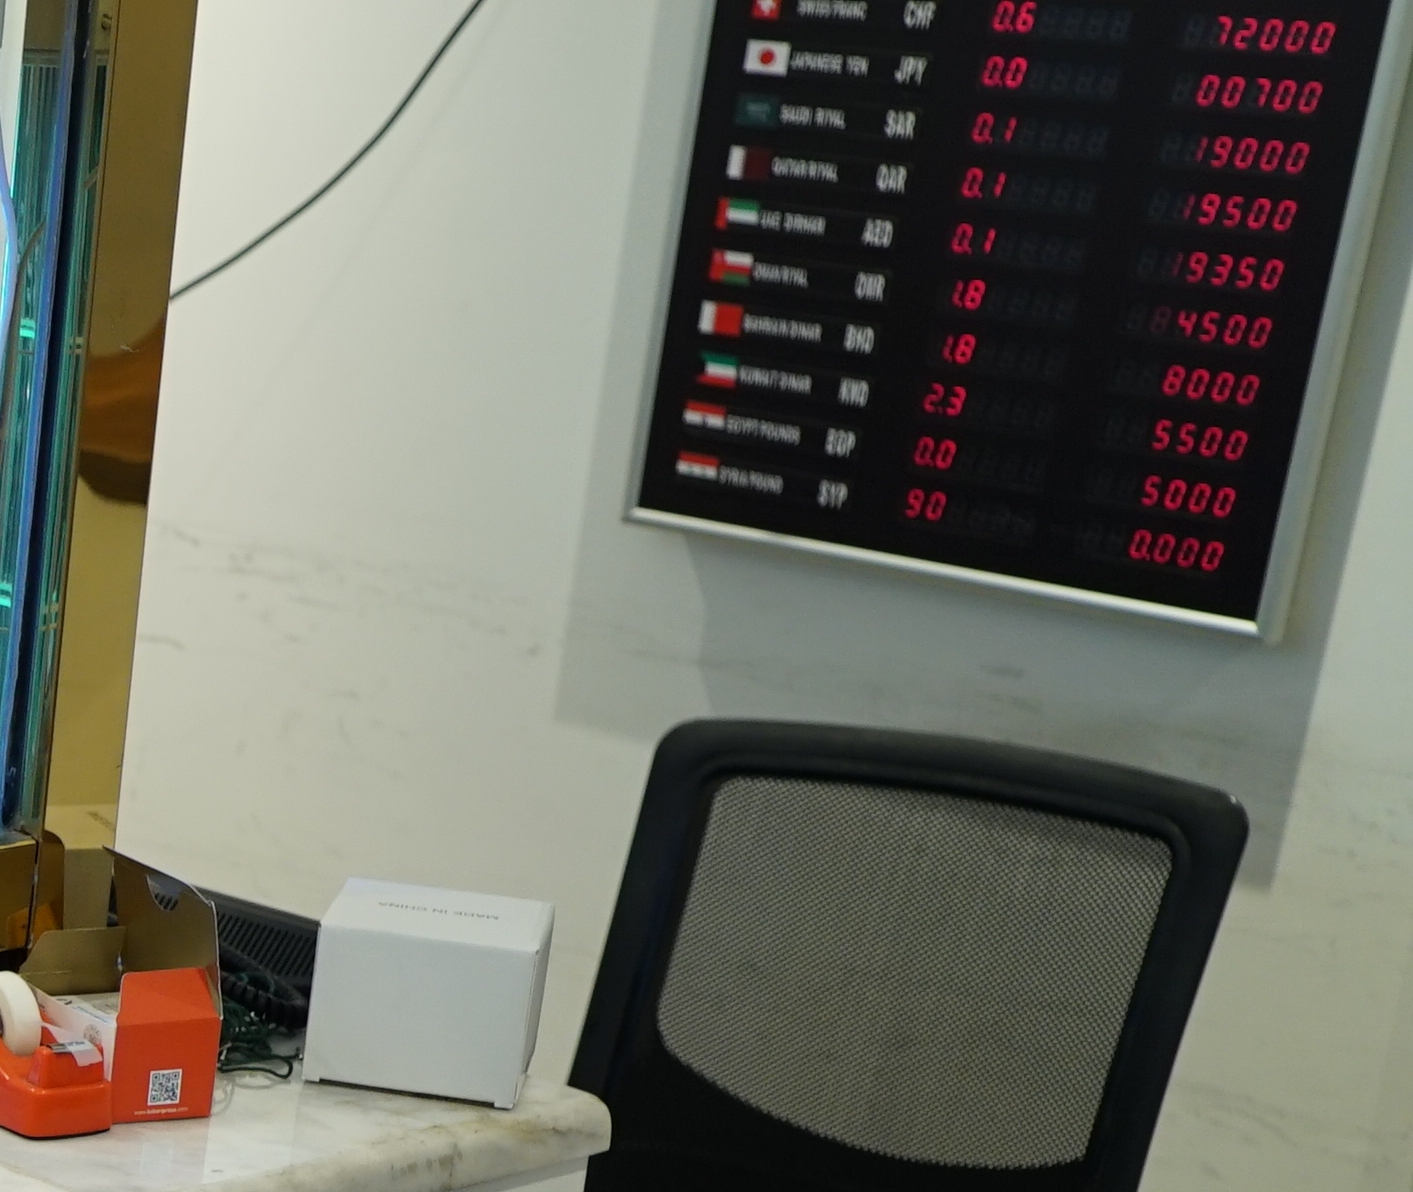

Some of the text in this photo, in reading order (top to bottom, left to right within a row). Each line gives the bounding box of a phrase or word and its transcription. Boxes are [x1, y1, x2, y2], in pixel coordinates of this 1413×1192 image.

[903, 0, 937, 30] CHF
[992, 0, 1037, 34] 0.6
[1217, 15, 1337, 55] 72000
[894, 55, 928, 86] JPY
[981, 56, 1028, 89] 0.0
[1196, 74, 1324, 114] 00700
[884, 109, 917, 140] SAR
[1195, 135, 1311, 175] 19000
[1182, 193, 1298, 232] 19500
[861, 218, 893, 248] AED
[855, 271, 886, 301] OMR
[1173, 251, 1285, 292] 19350
[844, 323, 875, 354] BHD
[838, 376, 869, 408] KWD
[923, 382, 967, 417] 2.3
[1162, 364, 1261, 407] 8000
[825, 427, 856, 458] EGP
[914, 436, 957, 470] 0.0
[1152, 418, 1249, 462] 5500
[817, 479, 848, 510] SYP
[904, 488, 947, 521] 90
[1142, 475, 1237, 519] 5000
[1129, 529, 1225, 572] 0.000
